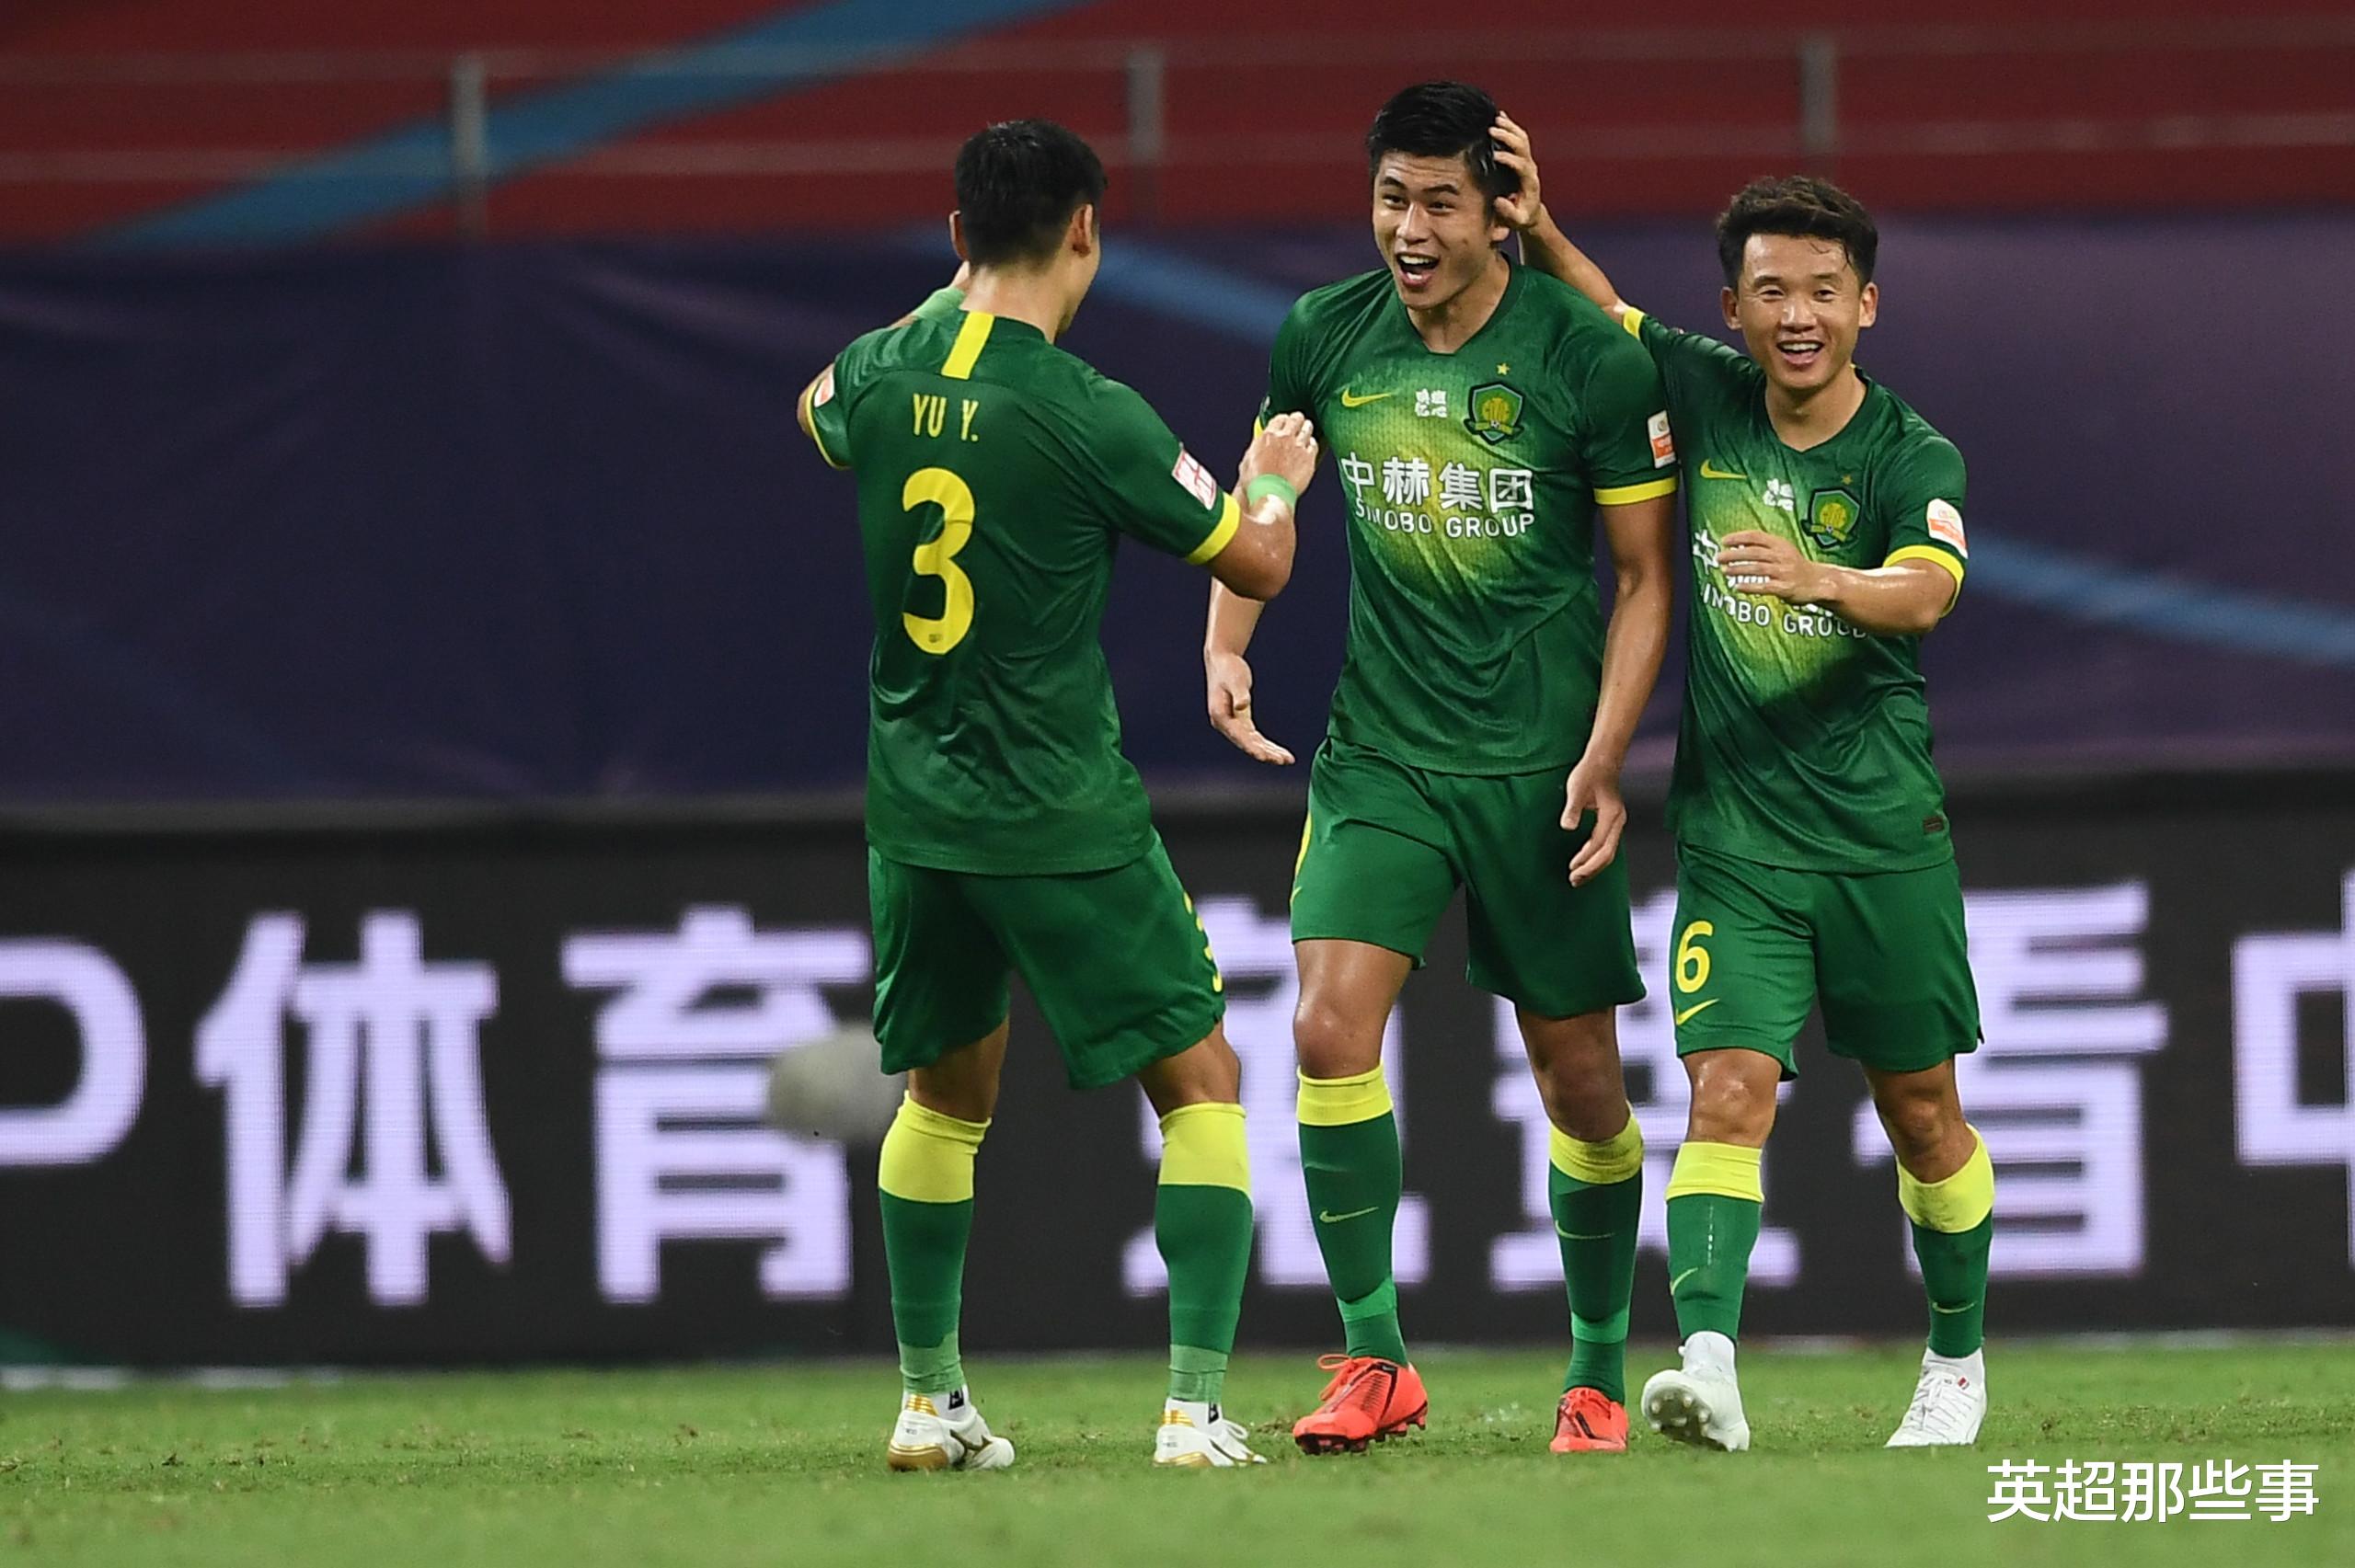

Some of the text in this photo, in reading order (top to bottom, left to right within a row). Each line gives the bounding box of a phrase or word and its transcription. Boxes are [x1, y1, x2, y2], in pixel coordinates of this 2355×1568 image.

[913, 394, 980, 441] YU Y.
[1340, 452, 1534, 513] 中赫集团
[1445, 513, 1535, 538] GROUP
[902, 467, 974, 655] 3
[1676, 921, 1713, 993] 6
